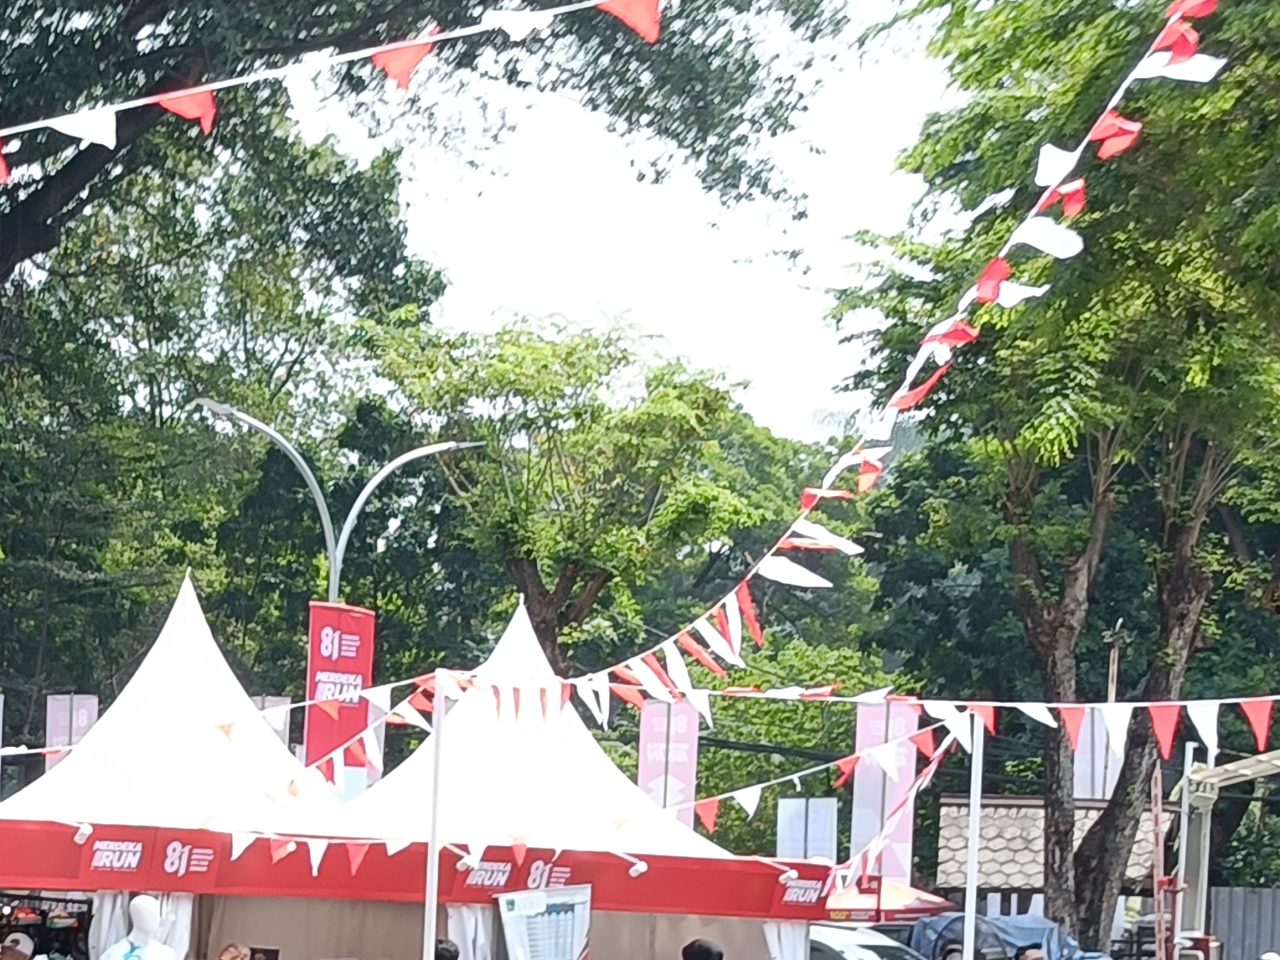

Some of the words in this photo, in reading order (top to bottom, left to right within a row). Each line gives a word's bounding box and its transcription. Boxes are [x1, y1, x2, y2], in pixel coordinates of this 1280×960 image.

[321, 626, 340, 661] 81
[324, 682, 360, 703] RUN
[92, 840, 142, 851] MERDEKA
[99, 850, 140, 868] RUN
[164, 840, 192, 877] 81
[473, 869, 510, 887] RUN
[527, 860, 553, 890] 81
[791, 887, 821, 903] RUN
